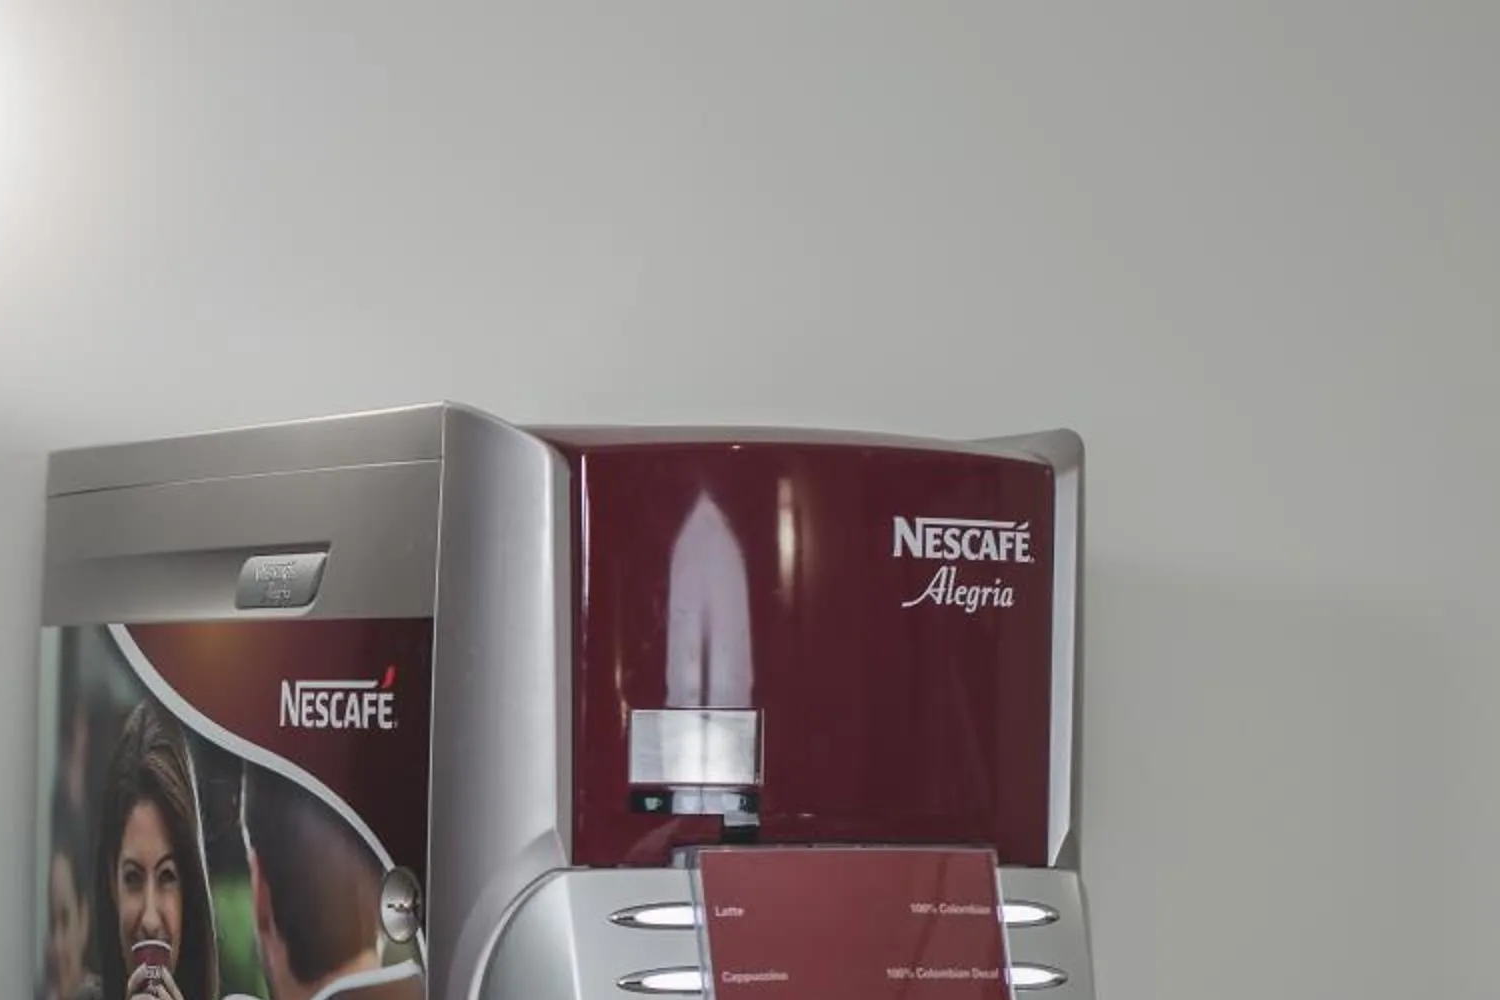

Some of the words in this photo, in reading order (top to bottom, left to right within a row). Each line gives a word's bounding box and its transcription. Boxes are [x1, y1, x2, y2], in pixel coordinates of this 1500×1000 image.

[893, 516, 1031, 562] NESCAFÉ
[902, 565, 1014, 614] Alegria
[279, 665, 397, 729] NESCAFÉ
